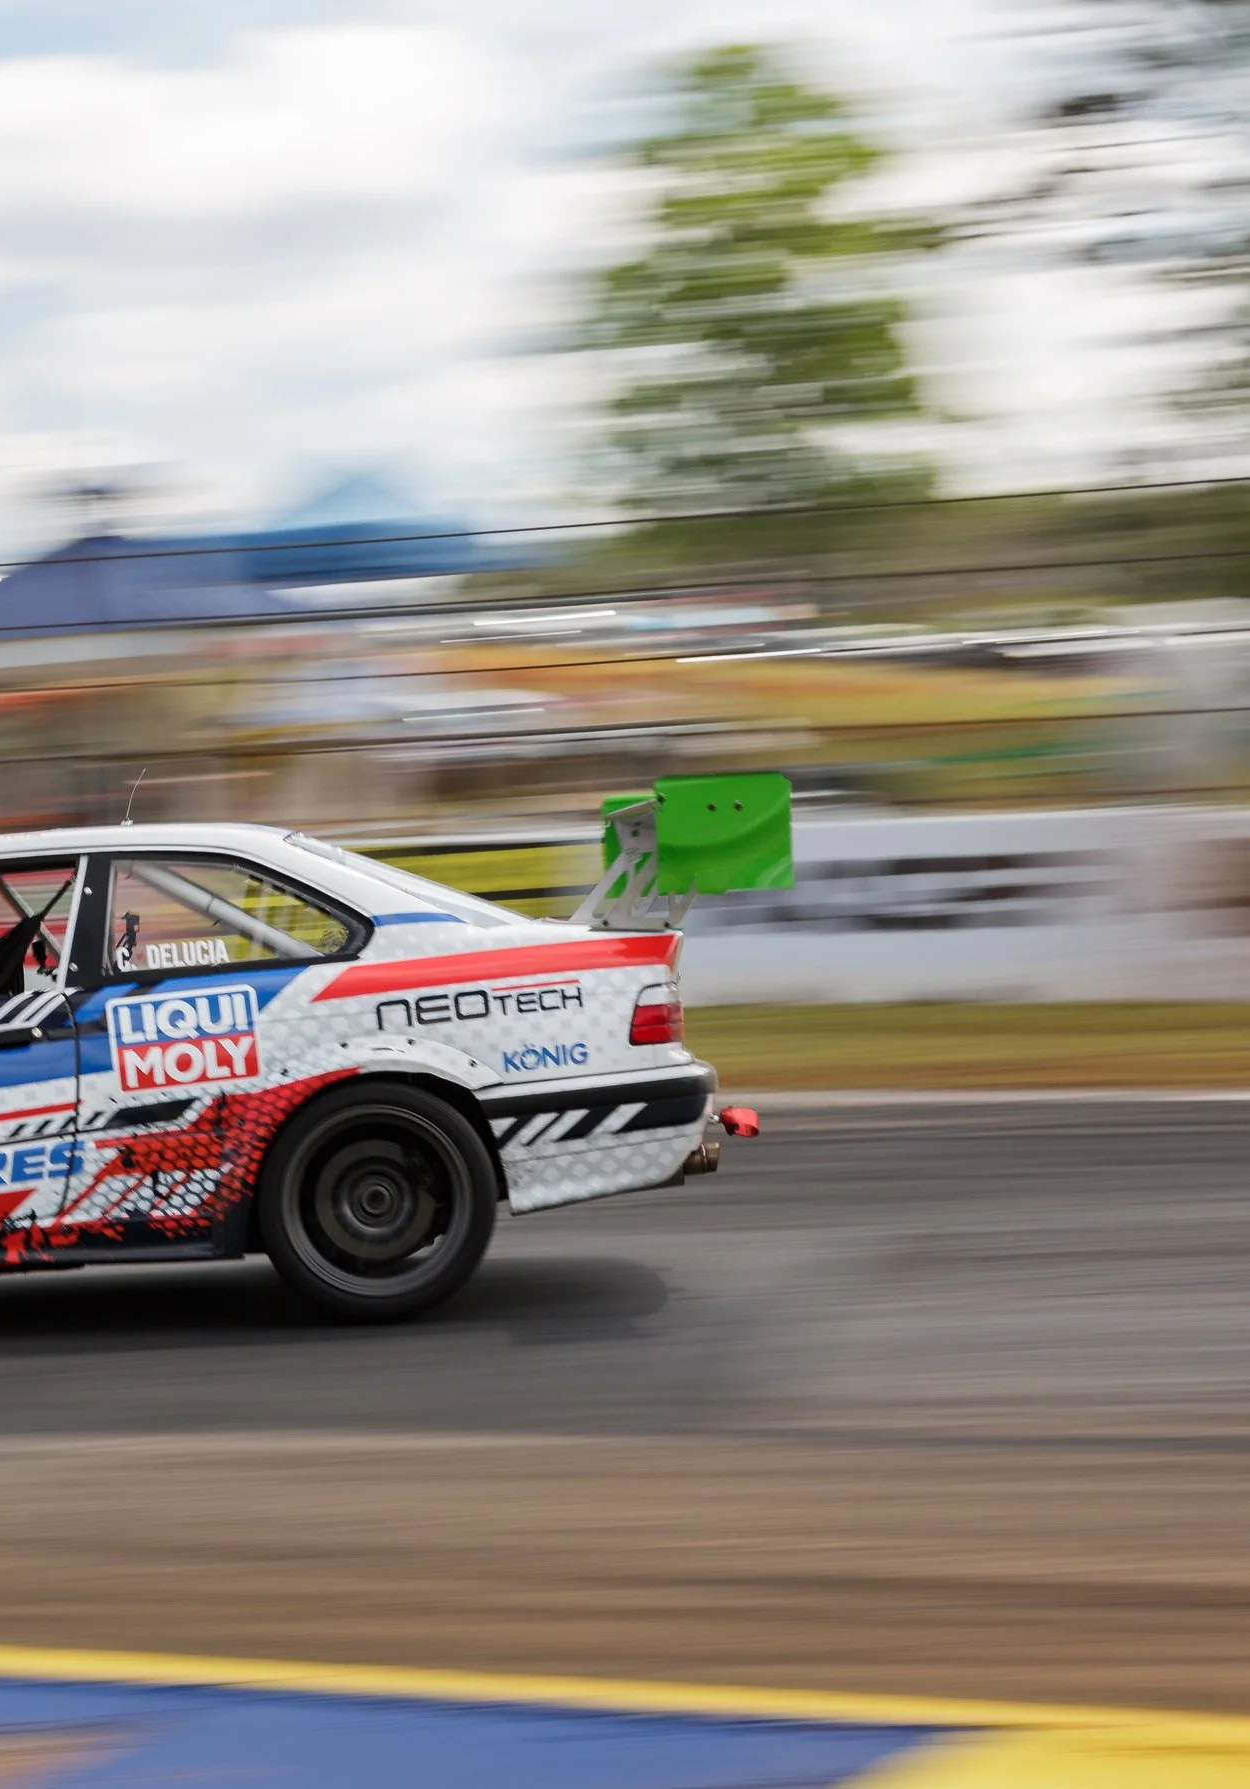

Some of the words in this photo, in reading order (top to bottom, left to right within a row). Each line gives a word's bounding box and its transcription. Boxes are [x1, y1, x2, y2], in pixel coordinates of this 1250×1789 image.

[116, 948, 137, 972] C.
[146, 938, 230, 968] DELUCIA
[117, 993, 249, 1044] LIQUI
[123, 1036, 254, 1089] MOLY
[503, 1042, 589, 1073] KÖNIG
